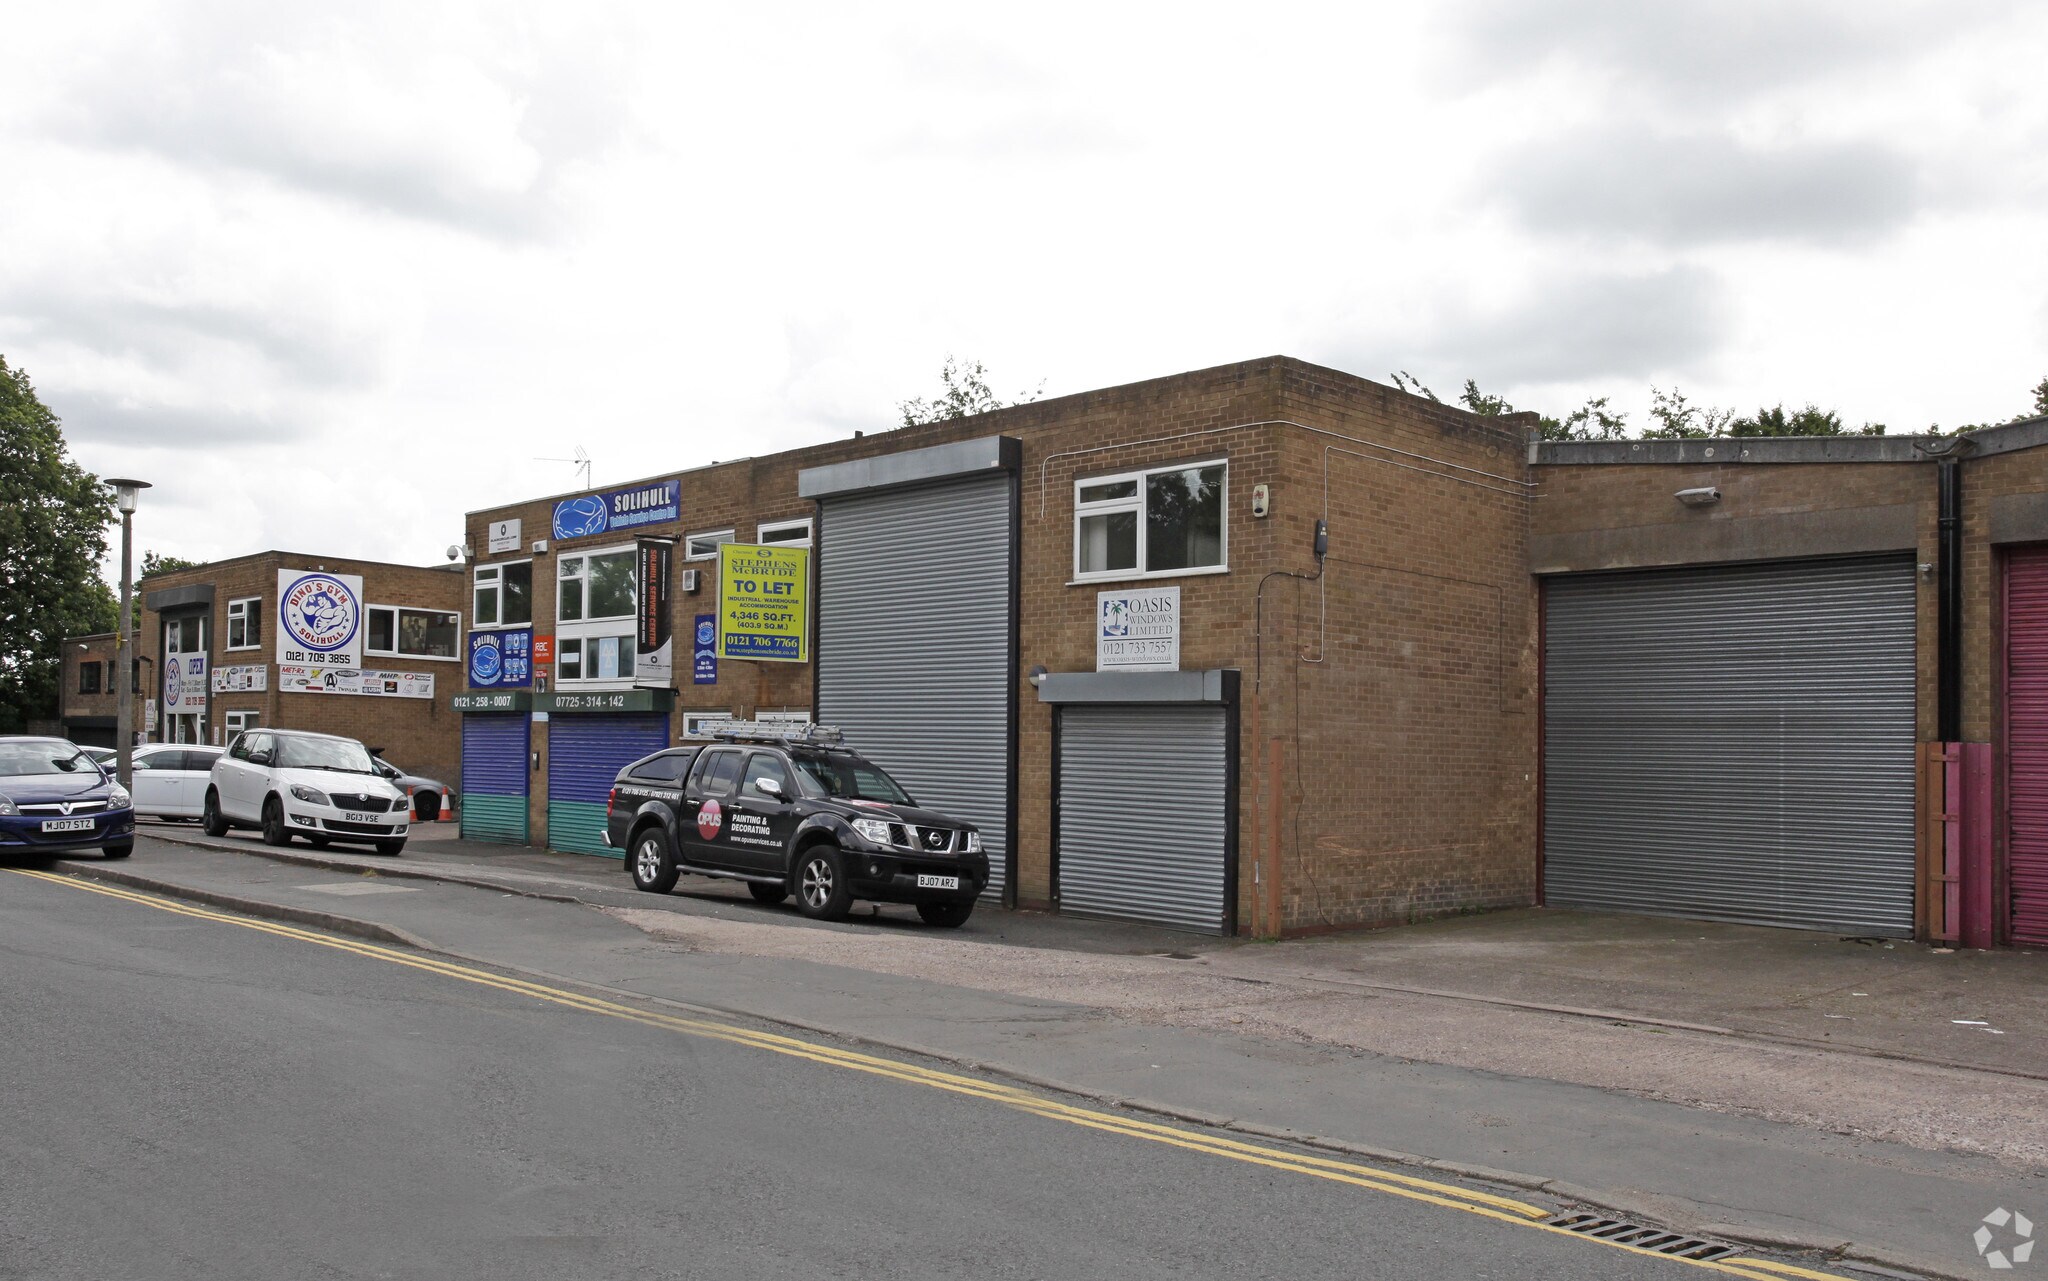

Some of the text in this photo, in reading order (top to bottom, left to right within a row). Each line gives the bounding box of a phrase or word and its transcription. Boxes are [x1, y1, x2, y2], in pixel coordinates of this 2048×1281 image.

[615, 486, 670, 512] SOLIHULL
[732, 559, 797, 568] STEPHENS
[732, 567, 797, 576] McBRIDE
[734, 580, 794, 594] TO LET
[290, 582, 348, 606] DINO'S GYM
[1130, 597, 1172, 613] OASIS
[730, 611, 796, 622] 4,346 SQ.FT.
[1129, 614, 1172, 624] WINDOWS
[1130, 625, 1172, 635] LIMITED
[299, 628, 344, 644] SOLIHULL
[727, 636, 797, 647] 0121 706 7766
[473, 635, 500, 649] SOLIHULL
[1103, 641, 1172, 654] 0121 733 7557
[286, 651, 350, 664] 0121 709 3855
[189, 658, 203, 674] OPEN
[454, 697, 470, 707] 0121
[476, 697, 488, 706] 258
[494, 696, 511, 706] 0007
[556, 696, 579, 707] 07725
[586, 696, 601, 707] 314
[608, 696, 624, 707] 142
[346, 813, 362, 821] BG13
[698, 812, 722, 826] OPUS
[732, 814, 767, 825] PAINTING &
[46, 820, 90, 830] MJ07 STZ
[731, 824, 770, 835] DECORATING
[730, 836, 782, 847] www.opusservices.co.uk
[920, 877, 954, 887] BJ07 ARZ
